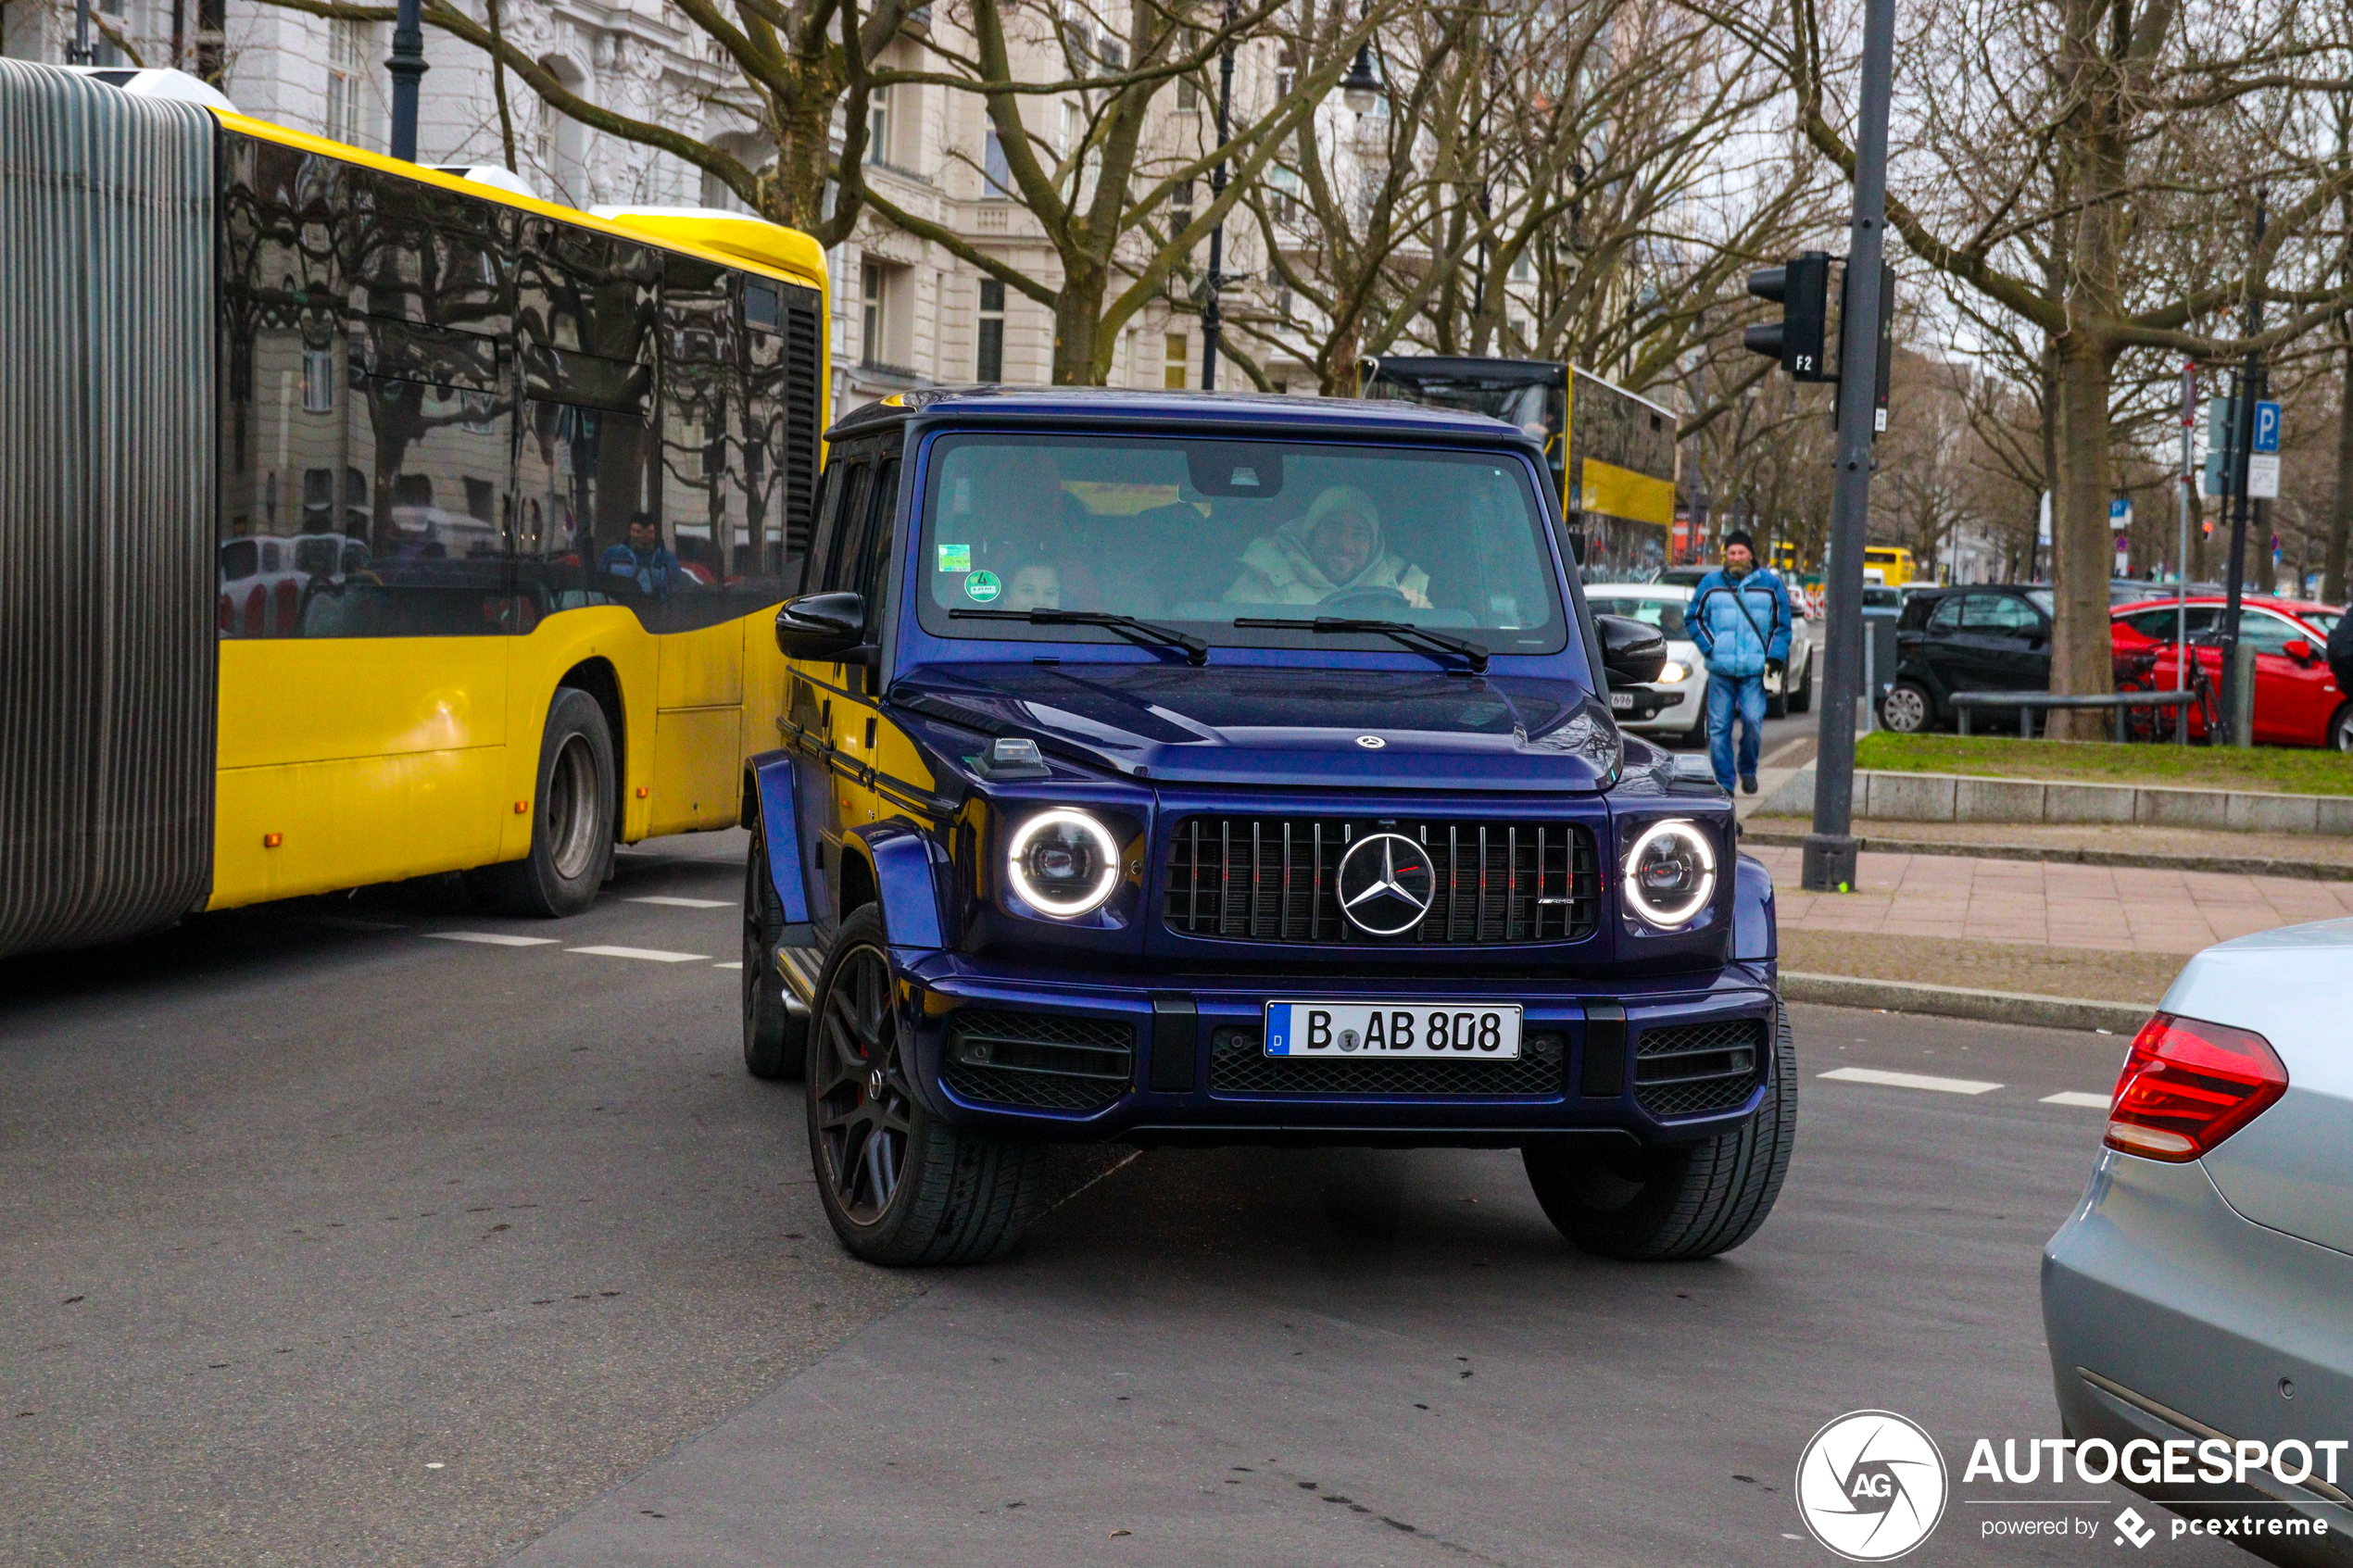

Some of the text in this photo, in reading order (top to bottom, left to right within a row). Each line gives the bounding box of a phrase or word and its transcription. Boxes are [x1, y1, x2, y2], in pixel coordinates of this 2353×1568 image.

[1796, 355, 1813, 371] F2
[2259, 408, 2275, 445] P
[977, 571, 988, 586] 4
[1307, 1010, 1501, 1052] B AB 808
[1274, 1035, 1282, 1047] D
